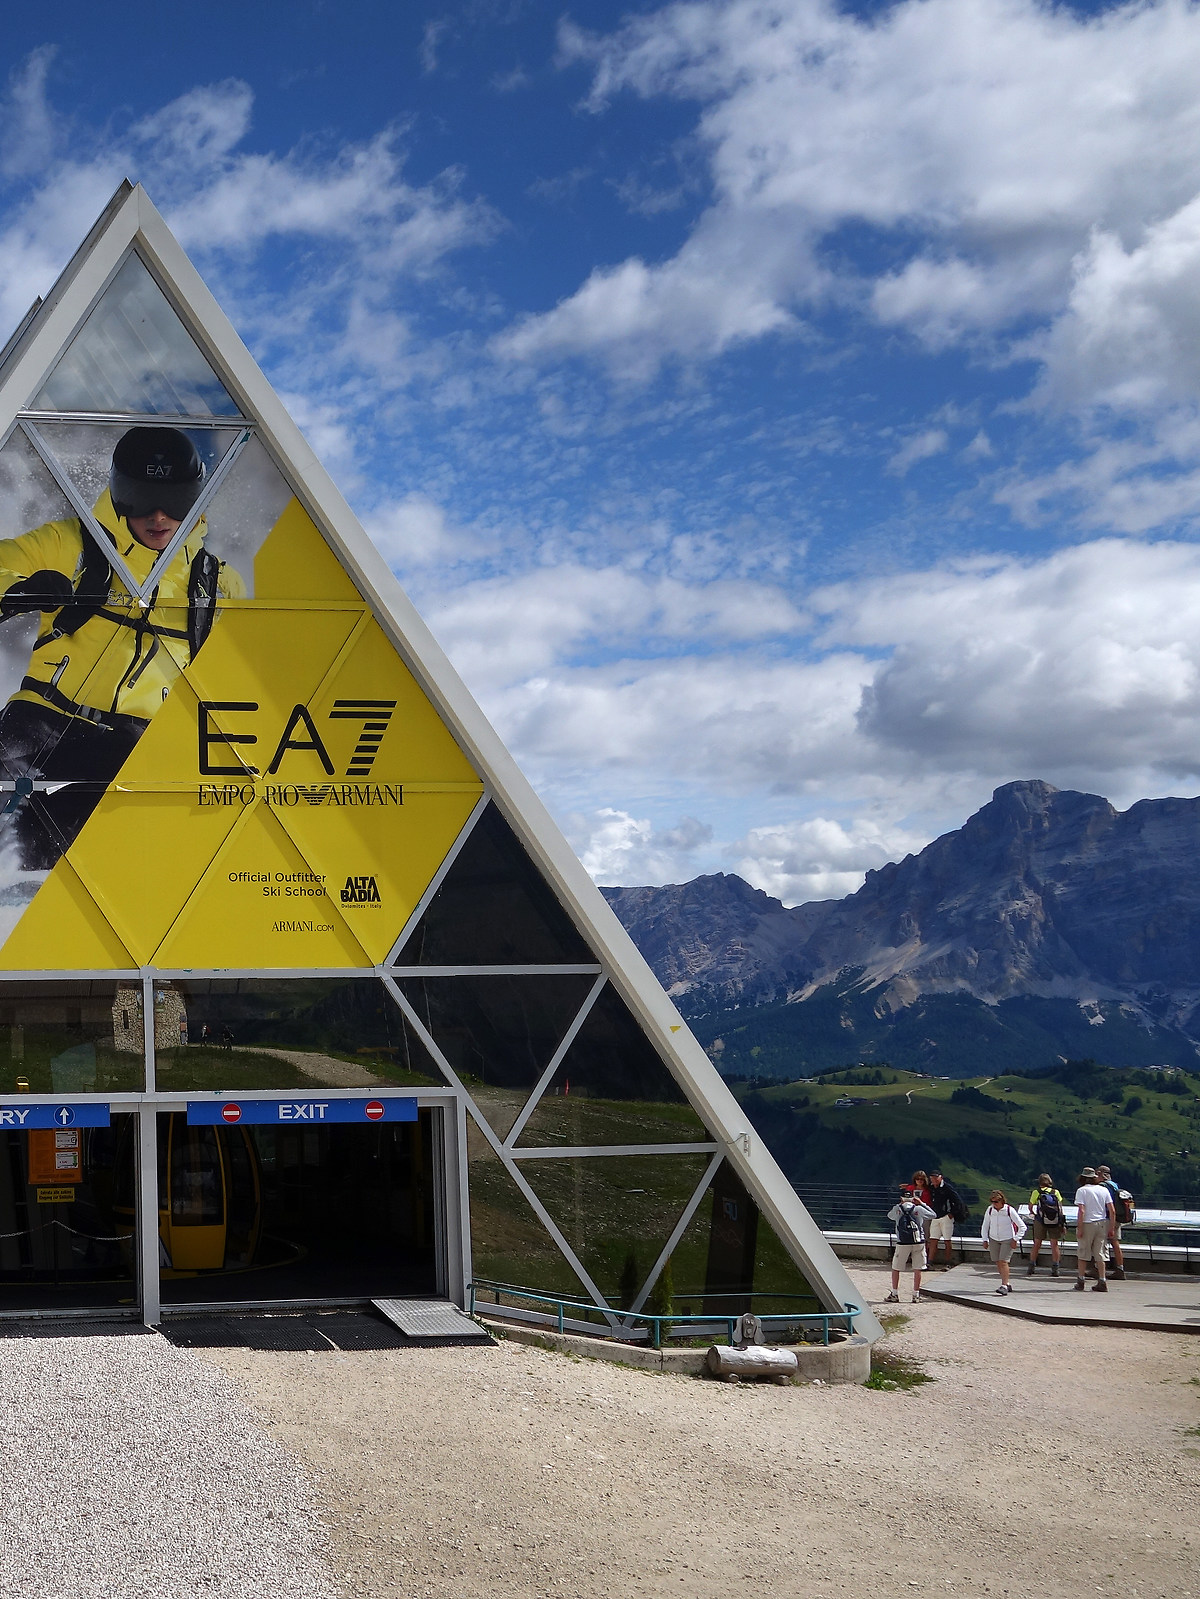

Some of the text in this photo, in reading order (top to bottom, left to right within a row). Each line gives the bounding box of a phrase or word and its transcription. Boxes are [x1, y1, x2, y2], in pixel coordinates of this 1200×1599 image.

[146, 464, 173, 476] EA7
[198, 700, 398, 776] EA7
[327, 784, 404, 806] ARMANI
[228, 872, 327, 883] Official Outfitter
[344, 876, 378, 890] ALTA
[262, 886, 327, 897] Ski School
[340, 889, 382, 902] BADIA
[278, 1104, 329, 1119] EXIT
